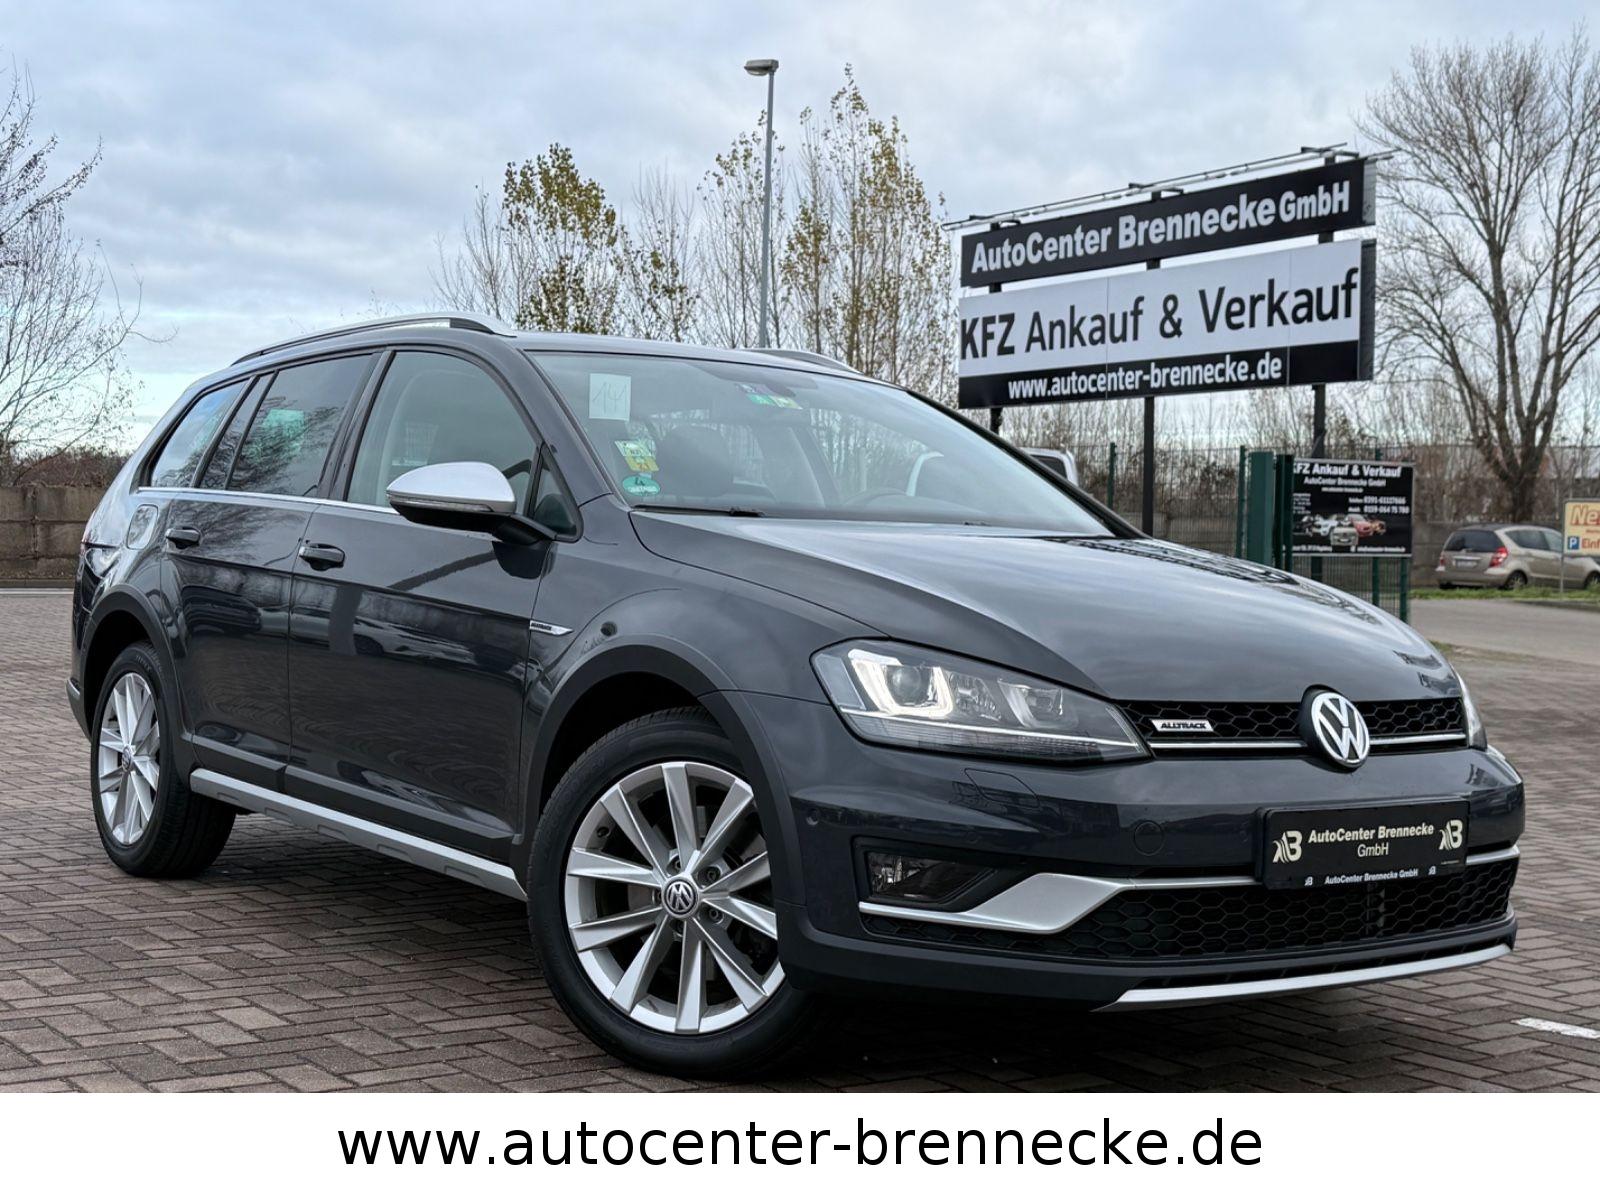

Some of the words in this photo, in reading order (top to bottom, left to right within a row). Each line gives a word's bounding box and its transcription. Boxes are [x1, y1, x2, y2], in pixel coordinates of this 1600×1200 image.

[971, 222, 1112, 274] AutoCenter
[1118, 193, 1277, 250] Brennecke
[1279, 180, 1351, 222] GmbH
[960, 312, 1016, 361] KFZ
[1025, 295, 1146, 353] Ankauf
[1158, 293, 1183, 340] &
[1199, 267, 1360, 334] Verkauf
[1008, 351, 1283, 400] www.autocenter-brennecke.de
[1312, 463, 1349, 476] Ankauf
[1351, 464, 1360, 477] &
[1362, 465, 1402, 478] Verkauf
[1160, 721, 1207, 730] ALLTRACK
[1308, 827, 1376, 844] AutoCenter
[1377, 822, 1435, 838] Brennecke
[1357, 842, 1390, 858] GmbH
[1324, 874, 1363, 885] AutoCenter
[1363, 871, 1398, 882] Brennecke
[1398, 868, 1419, 878] GmbH
